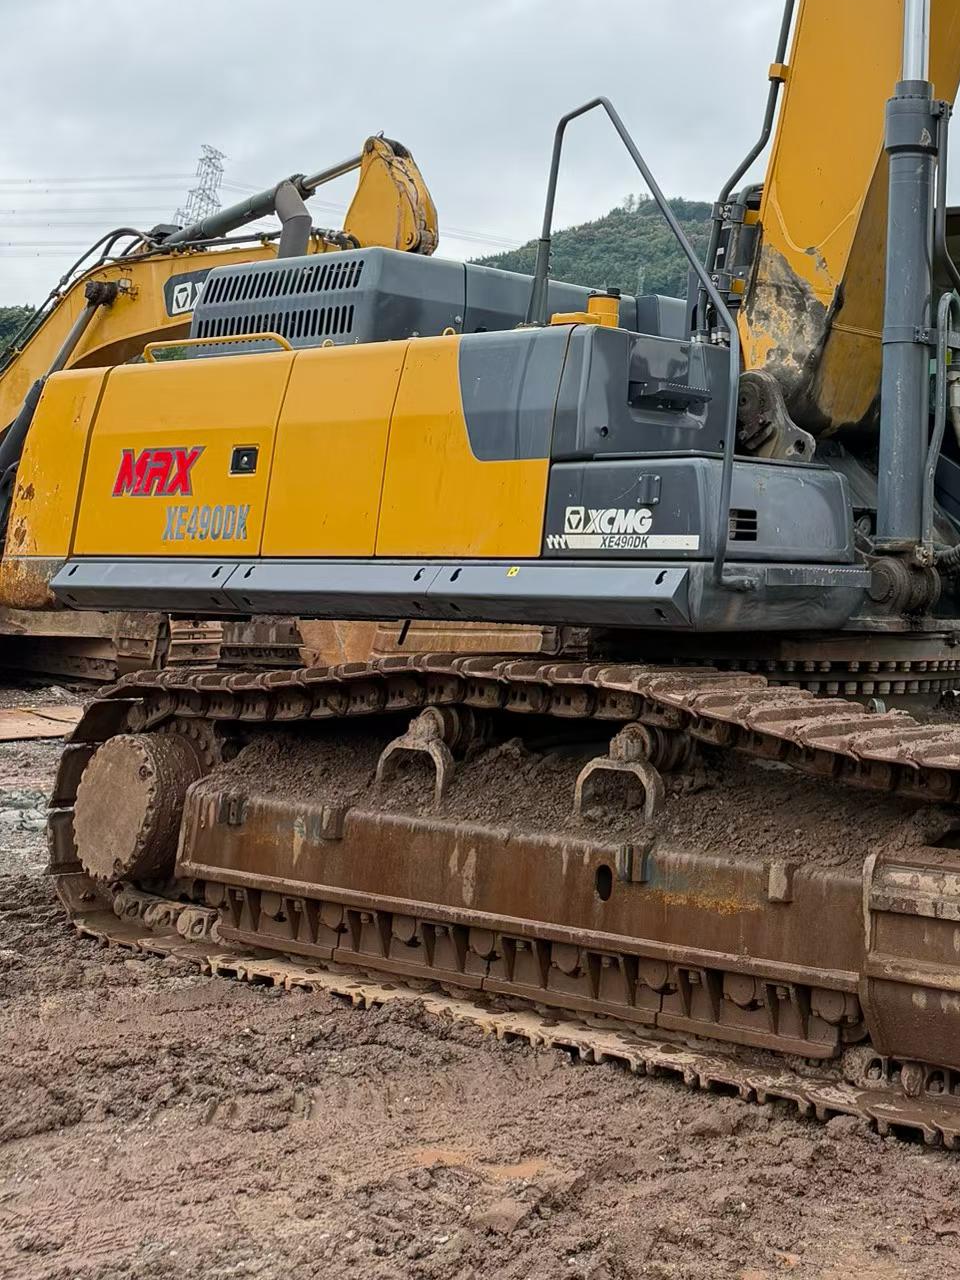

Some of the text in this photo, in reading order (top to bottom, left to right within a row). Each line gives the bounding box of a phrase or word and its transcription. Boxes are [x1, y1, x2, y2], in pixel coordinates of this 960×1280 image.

[112, 446, 207, 497] MAX
[162, 505, 250, 540] XE490DK
[583, 508, 653, 534] XCMG
[600, 536, 649, 548] XE490DK
